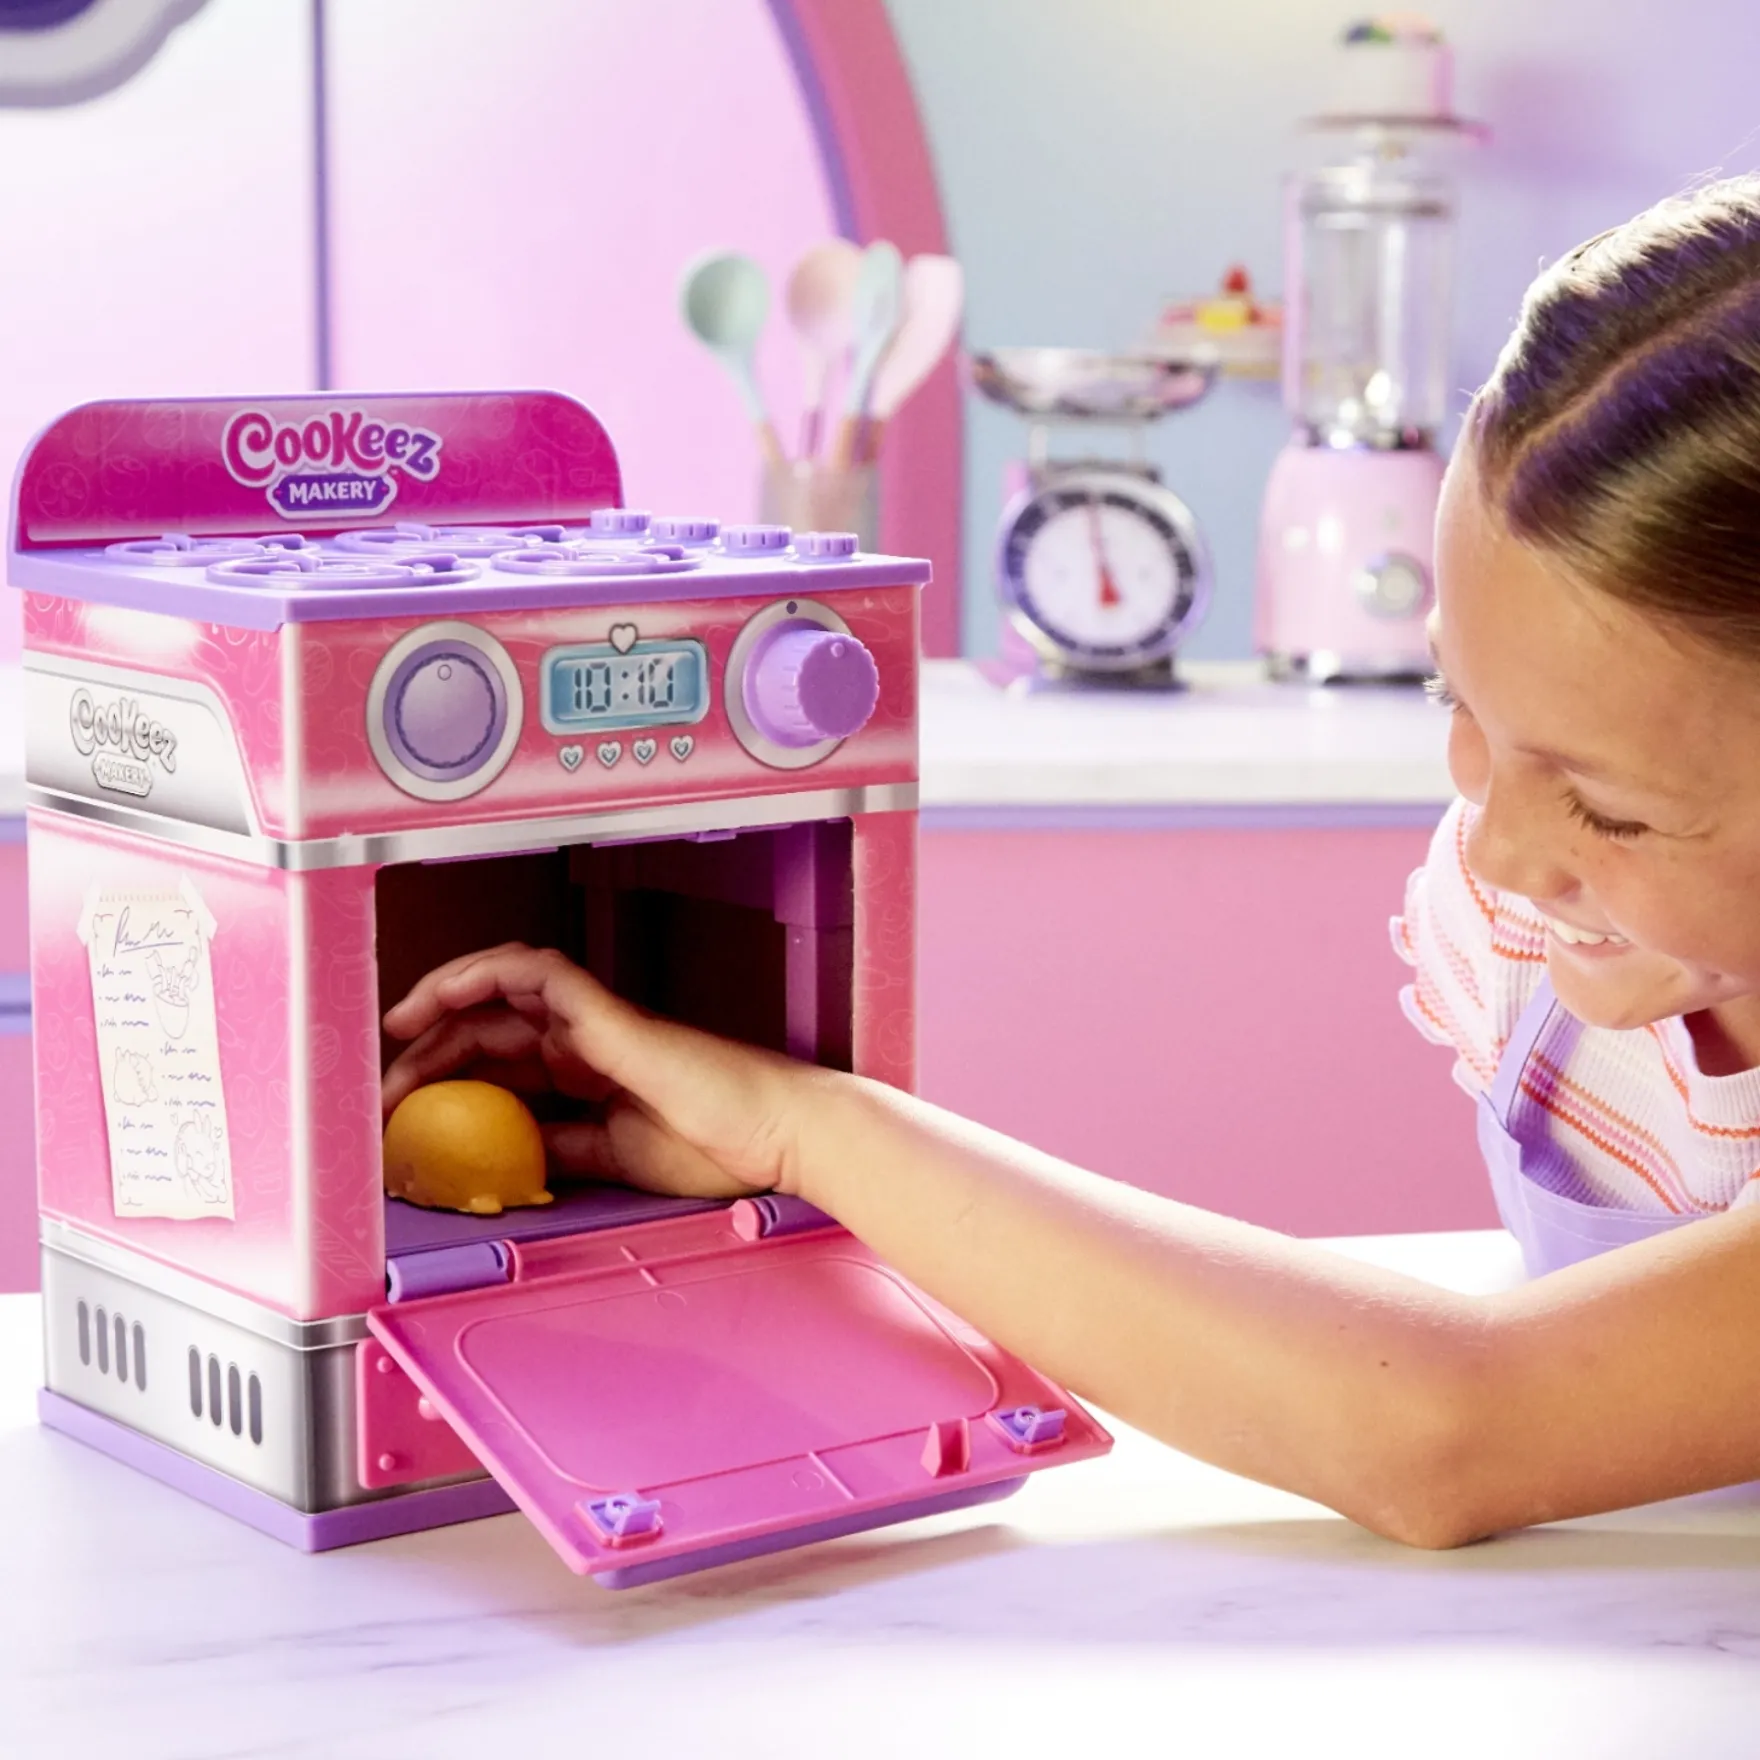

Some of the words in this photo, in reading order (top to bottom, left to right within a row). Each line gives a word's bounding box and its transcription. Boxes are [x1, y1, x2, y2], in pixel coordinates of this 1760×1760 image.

[288, 480, 377, 505] MAKERY
[573, 656, 674, 714] 10:10
[100, 757, 148, 789] MAKERY
